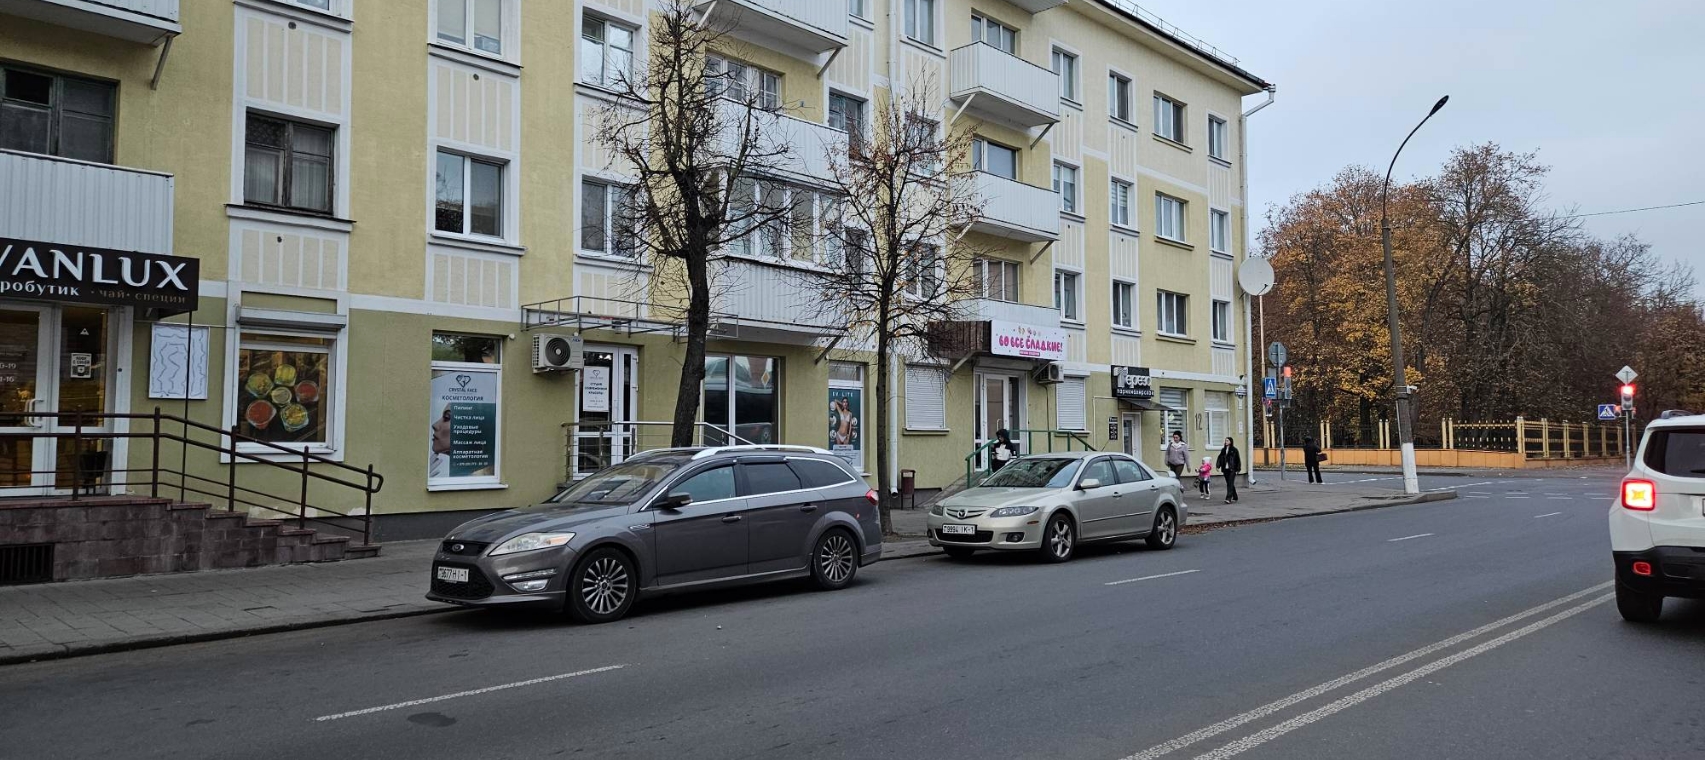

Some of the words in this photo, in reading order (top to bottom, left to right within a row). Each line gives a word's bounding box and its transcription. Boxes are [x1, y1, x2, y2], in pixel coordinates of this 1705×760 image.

[100, 288, 126, 300] чай
[135, 291, 186, 303] специи
[1195, 412, 1203, 431] 12
